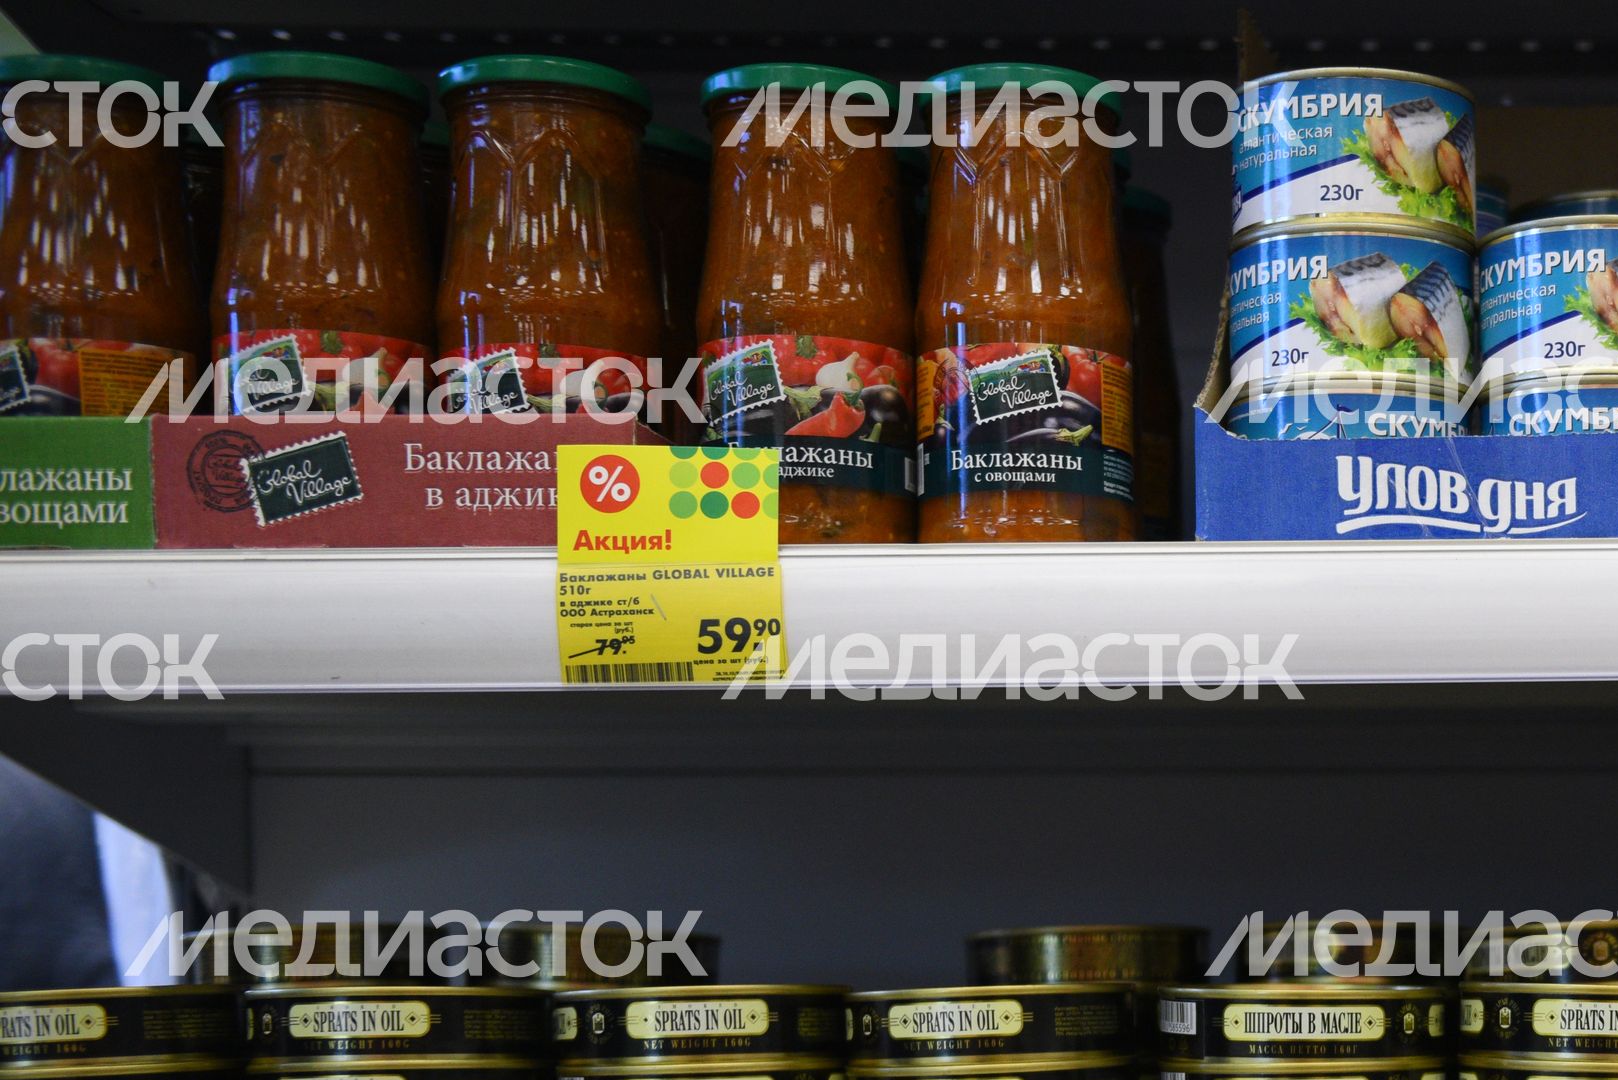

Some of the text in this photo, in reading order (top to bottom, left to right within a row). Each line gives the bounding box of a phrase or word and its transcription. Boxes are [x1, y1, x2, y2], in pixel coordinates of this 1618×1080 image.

[1238, 92, 1384, 134] СКУМБРИЯ
[1319, 184, 1364, 203] 230г
[1479, 247, 1607, 294] СКУМБРИЯ
[1271, 347, 1310, 368] 230г
[1543, 339, 1586, 360] 230г
[403, 443, 557, 473] Баклажа
[950, 449, 1083, 472] Баклажаны
[985, 471, 1056, 484] овощами
[286, 476, 352, 504] Village
[425, 487, 444, 508] в
[572, 529, 672, 554] Акция!
[560, 567, 775, 583] Баклажаны GLOBAL VILLAGE
[559, 585, 592, 596] 510г
[560, 608, 655, 619] ООО Астраханск
[570, 599, 613, 609] аджике
[313, 1011, 358, 1035] SPRATS
[361, 1010, 376, 1032] IN
[379, 1009, 405, 1031] OIL
[655, 1008, 746, 1032] SPRATS IN OIL
[1244, 1012, 1362, 1035] ШПРОТЫ В МАСЛЕ
[1559, 1009, 1605, 1031] SPRATS
